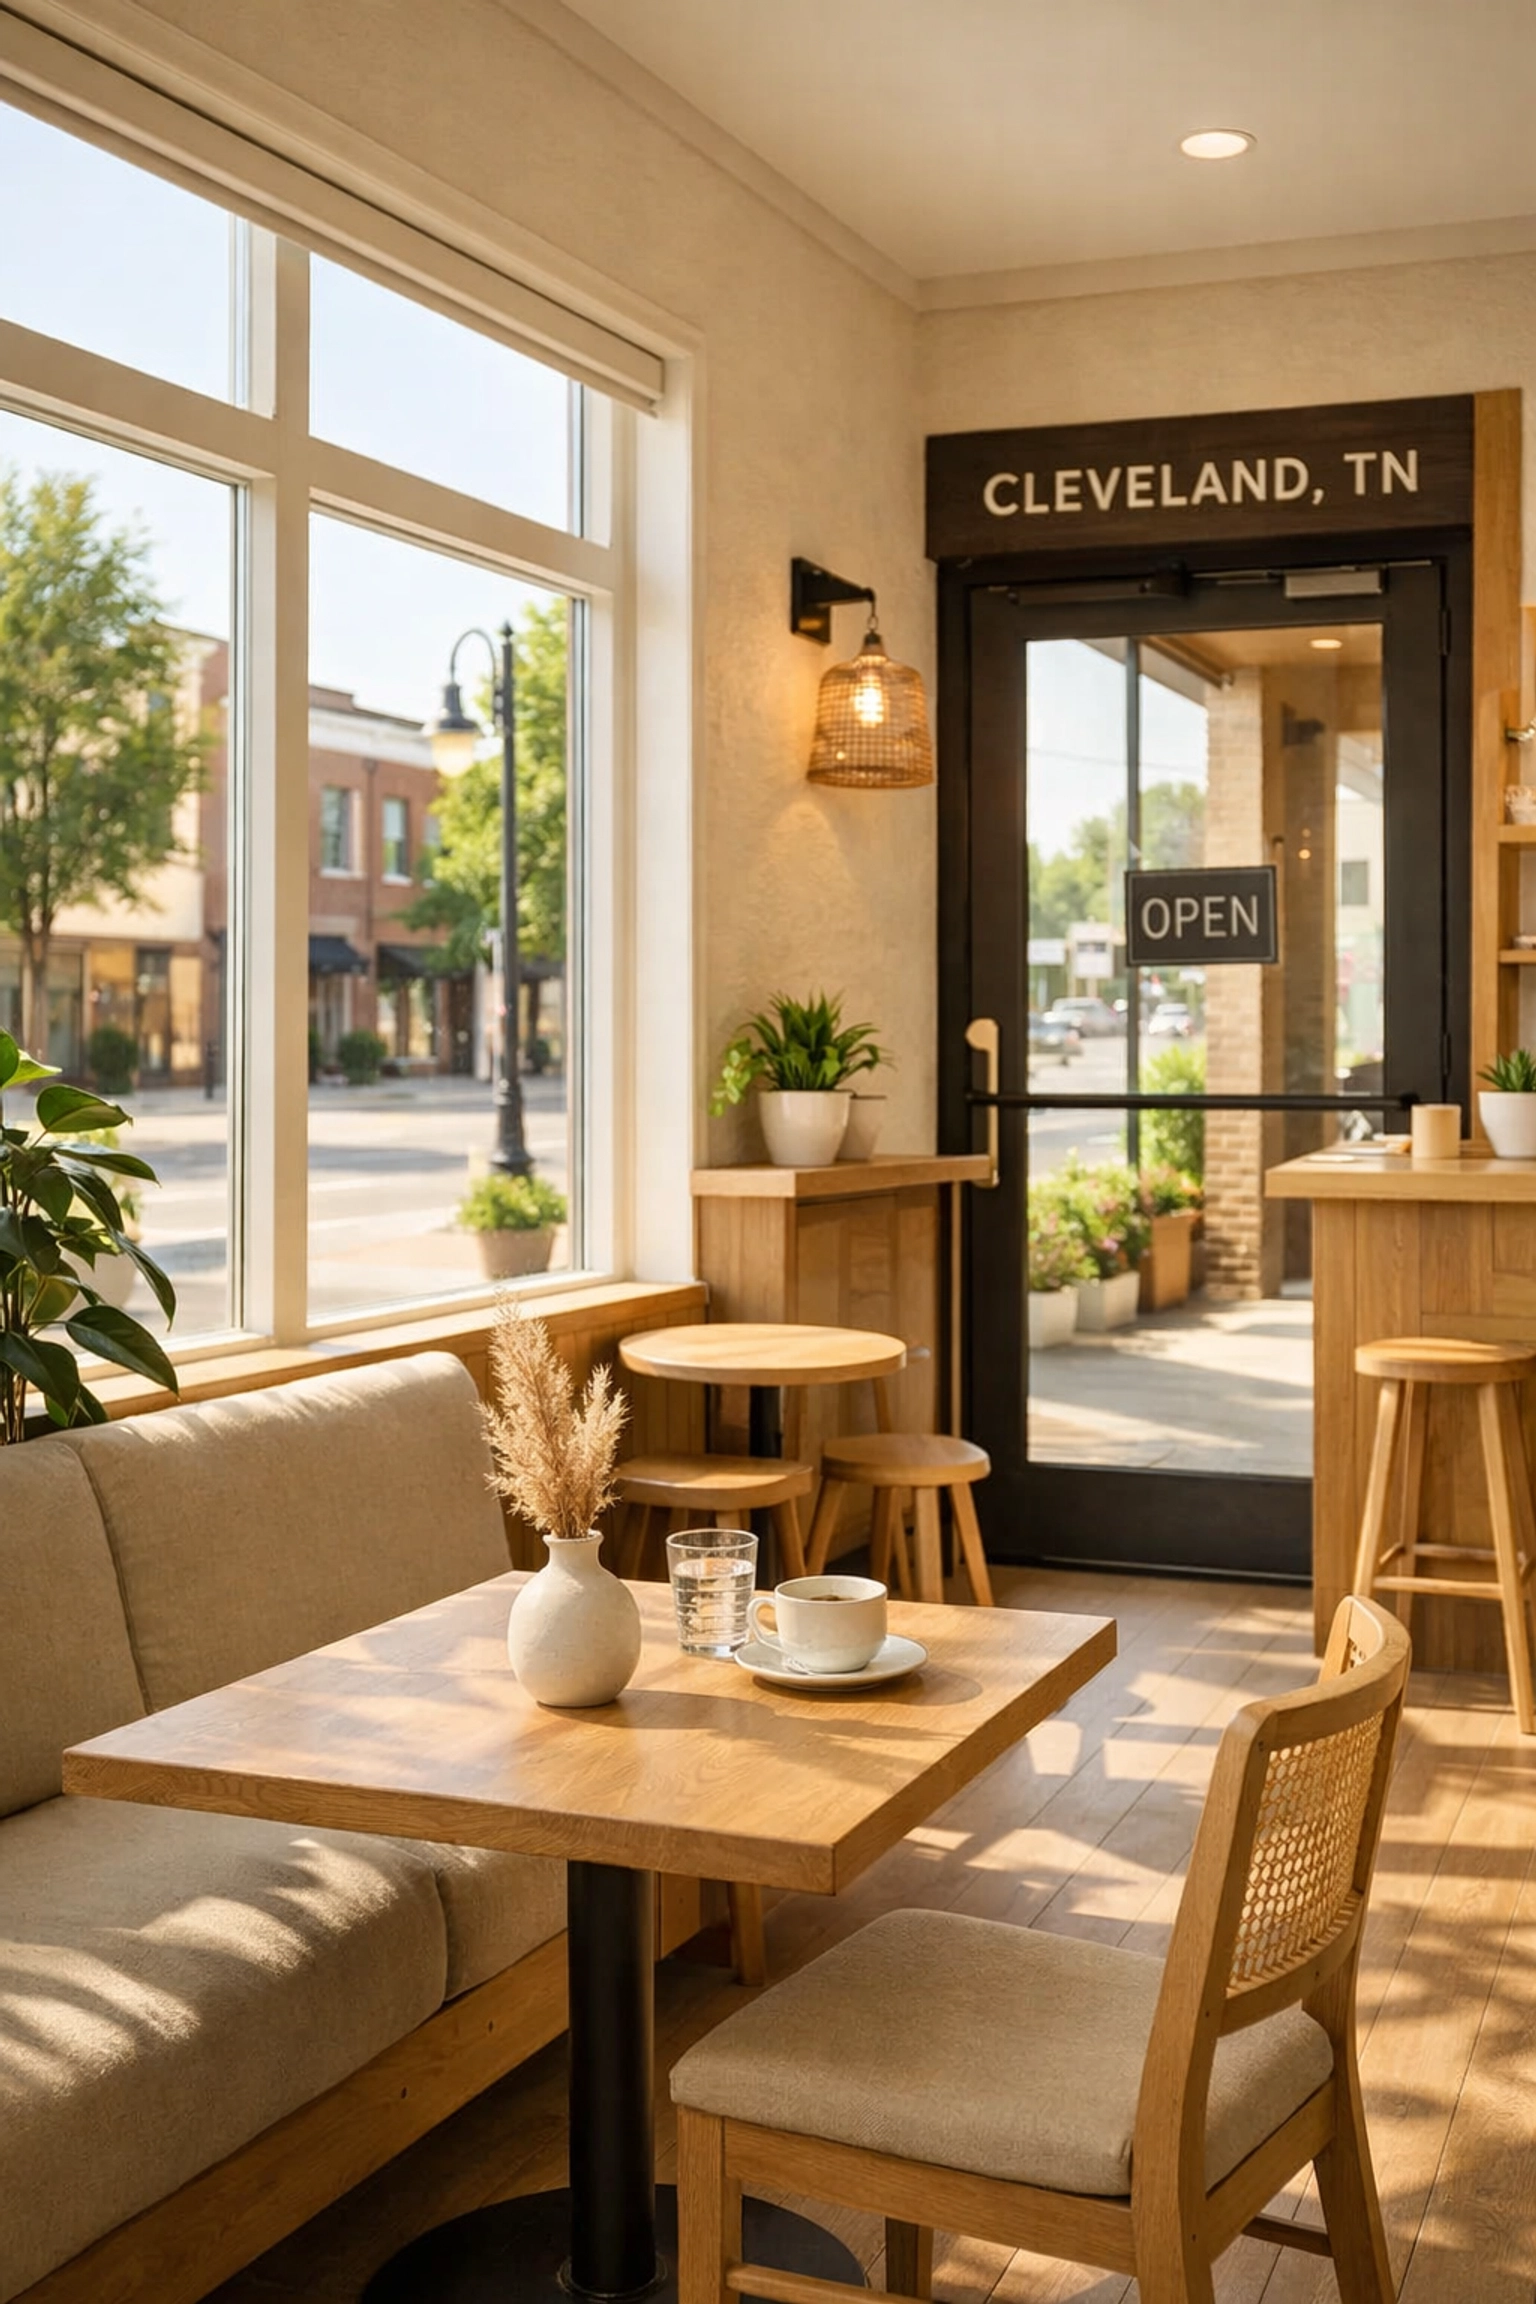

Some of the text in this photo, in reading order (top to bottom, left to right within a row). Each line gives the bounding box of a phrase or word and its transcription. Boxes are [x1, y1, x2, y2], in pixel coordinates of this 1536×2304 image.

[983, 449, 1418, 516] CLEVELAND, TN
[1141, 894, 1258, 940] OPEN
